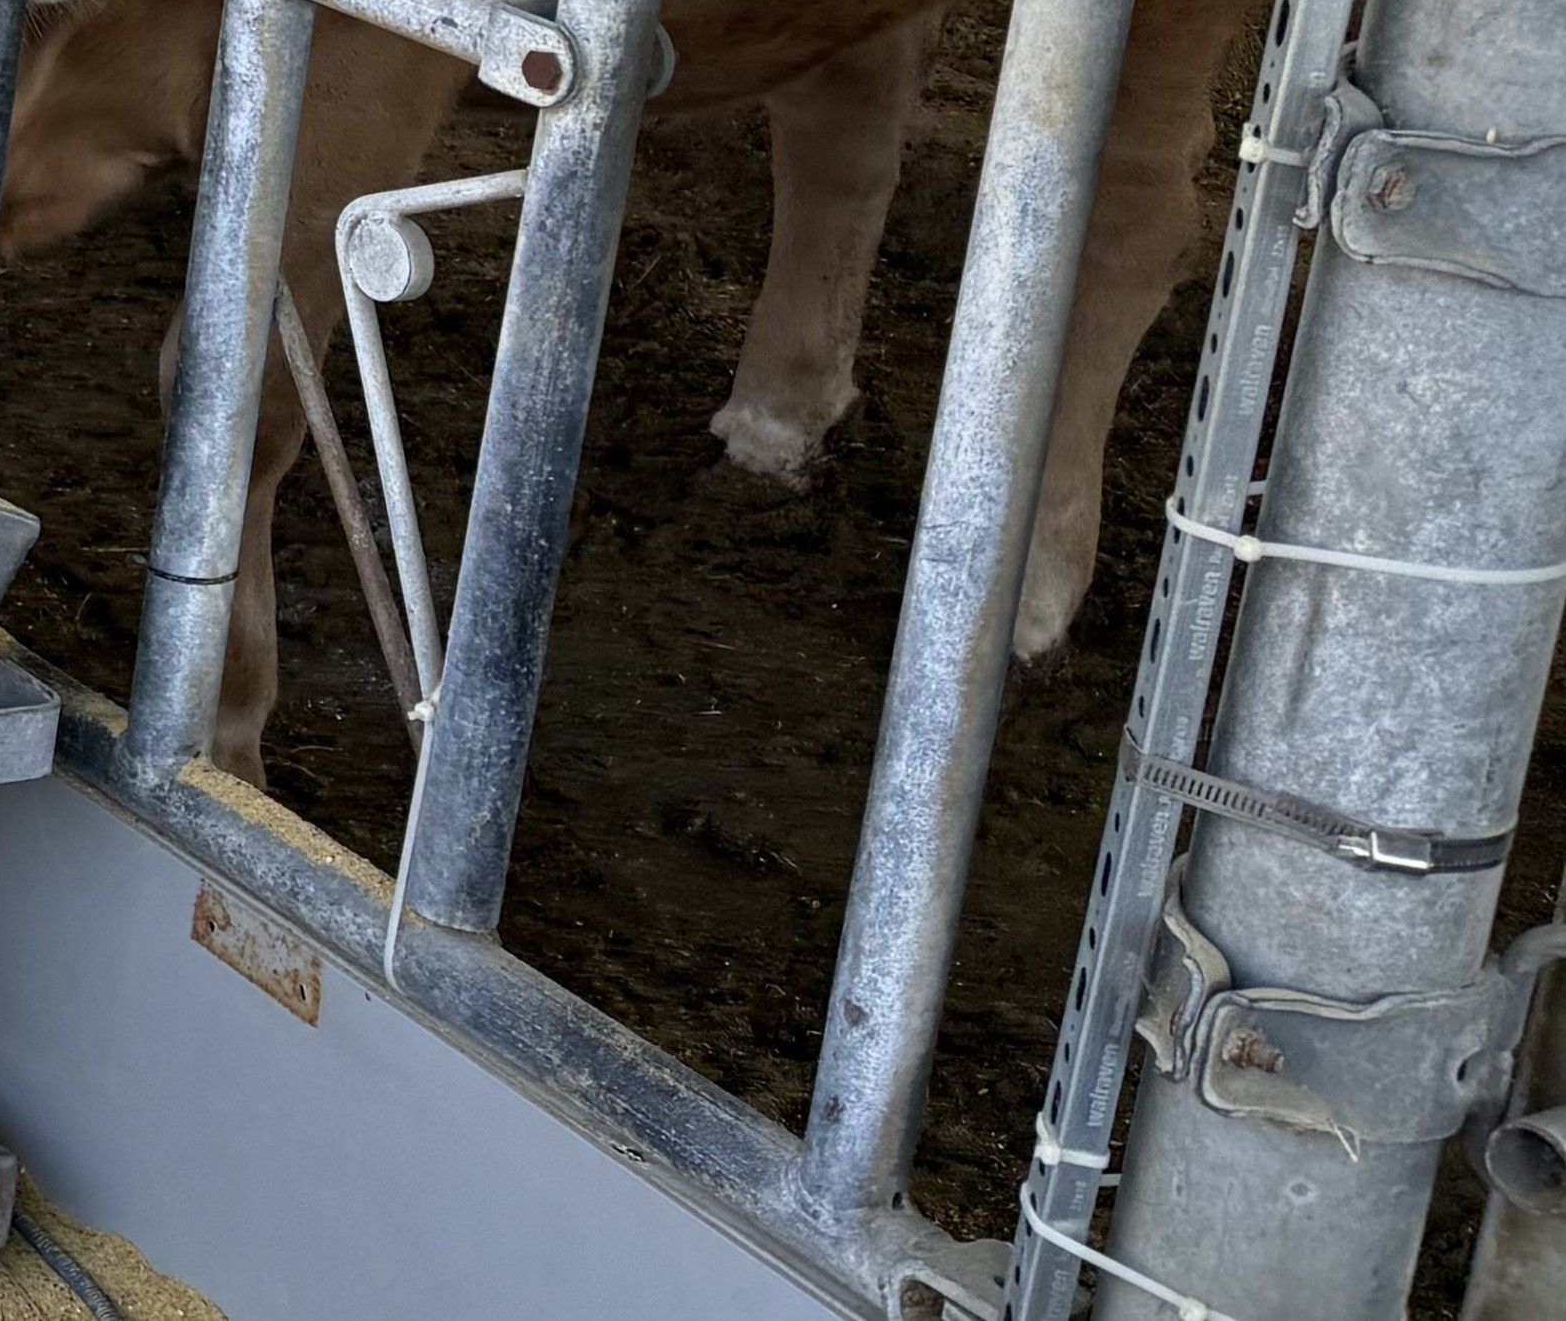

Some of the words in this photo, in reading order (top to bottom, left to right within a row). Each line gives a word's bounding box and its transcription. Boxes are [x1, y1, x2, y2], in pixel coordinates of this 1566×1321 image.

[1188, 570, 1223, 662] walraven
[1137, 810, 1171, 898] walraven
[1086, 1043, 1120, 1128] walraven
